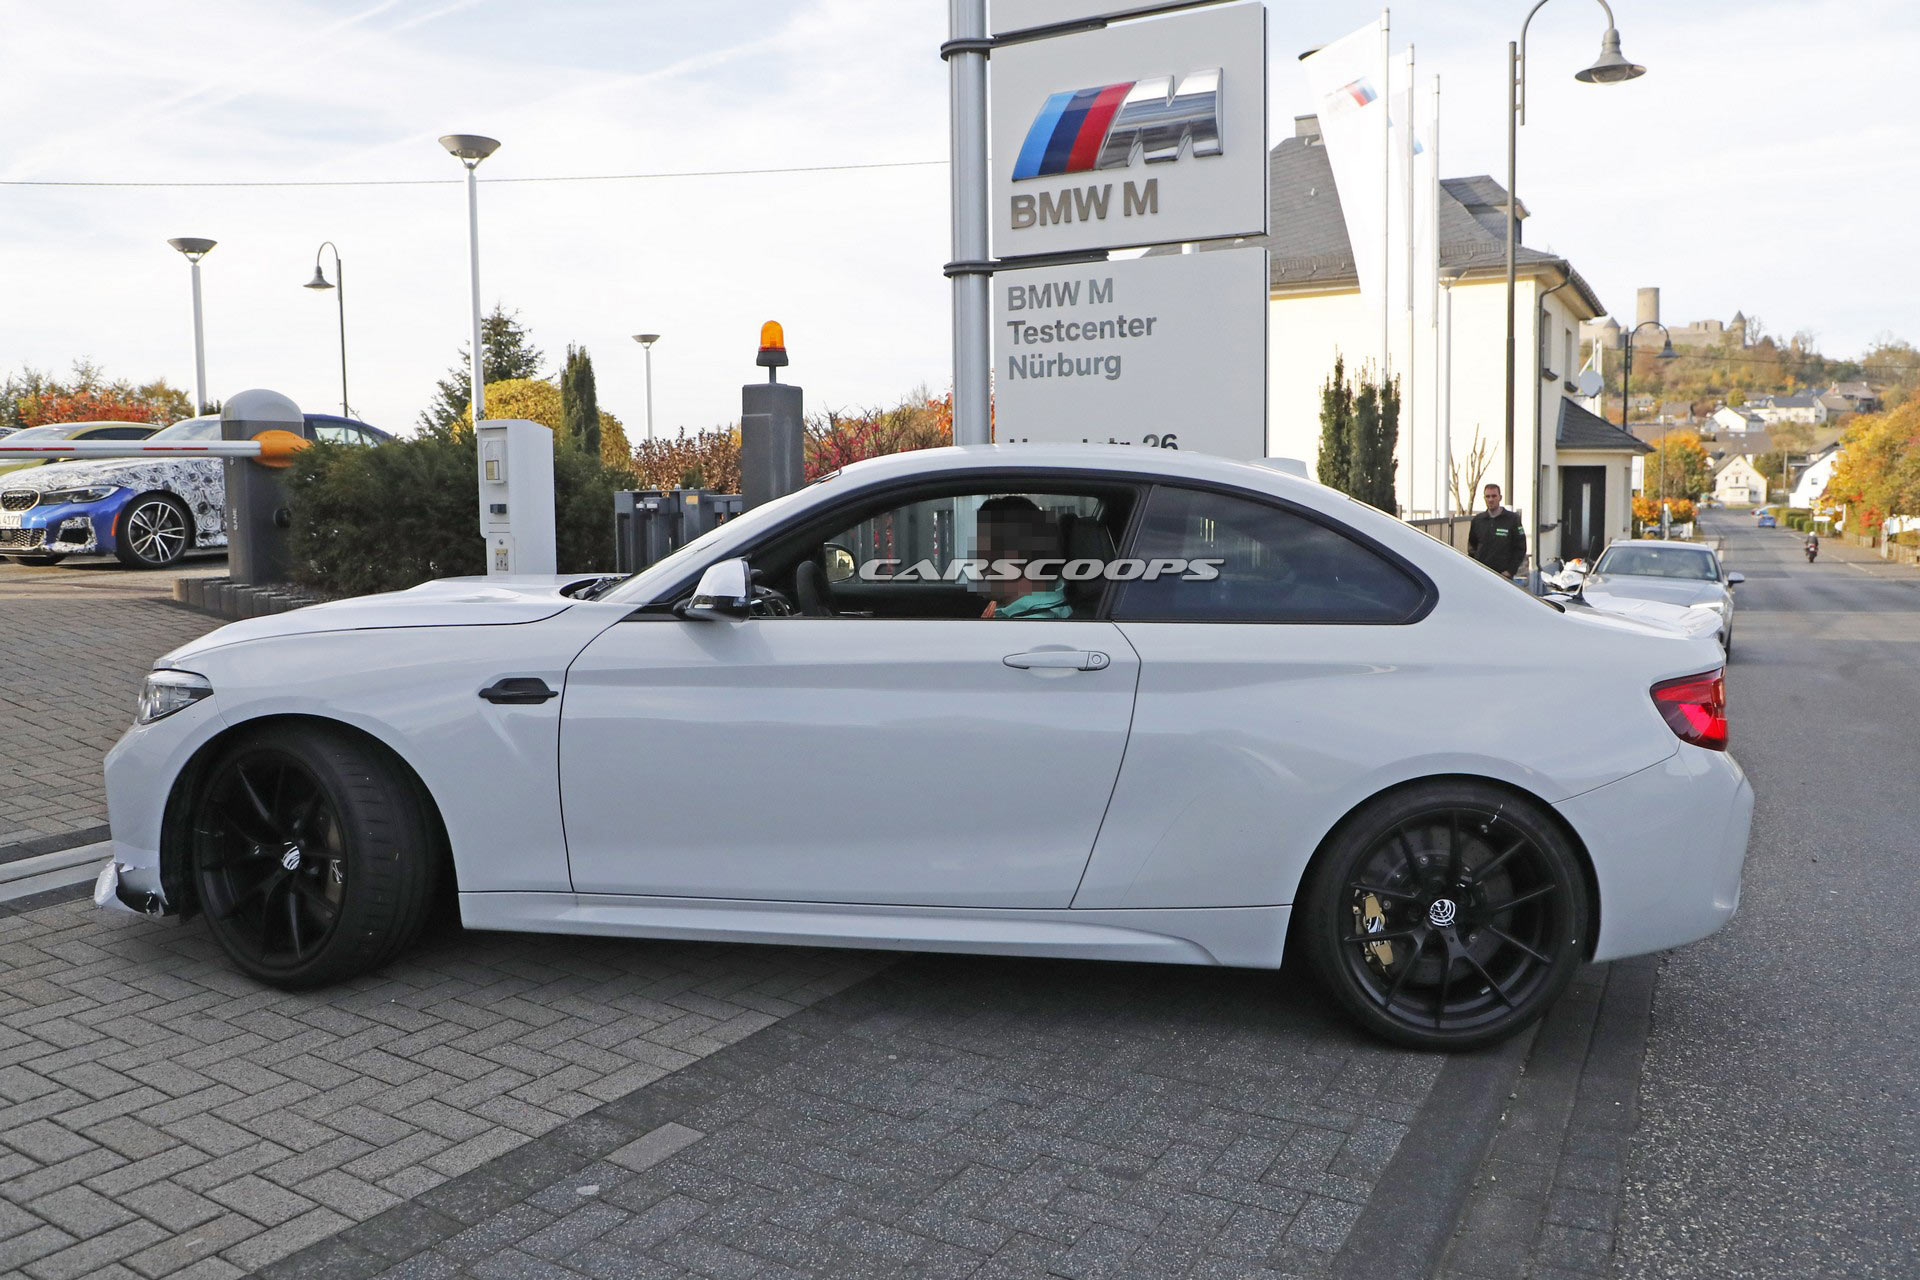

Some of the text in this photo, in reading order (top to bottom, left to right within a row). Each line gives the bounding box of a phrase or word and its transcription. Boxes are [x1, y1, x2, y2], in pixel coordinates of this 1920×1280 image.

[1011, 178, 1158, 229] BMW M
[1008, 278, 1113, 311] BMW M
[1007, 315, 1157, 345] Testcenter
[1008, 352, 1121, 381] Nürburg
